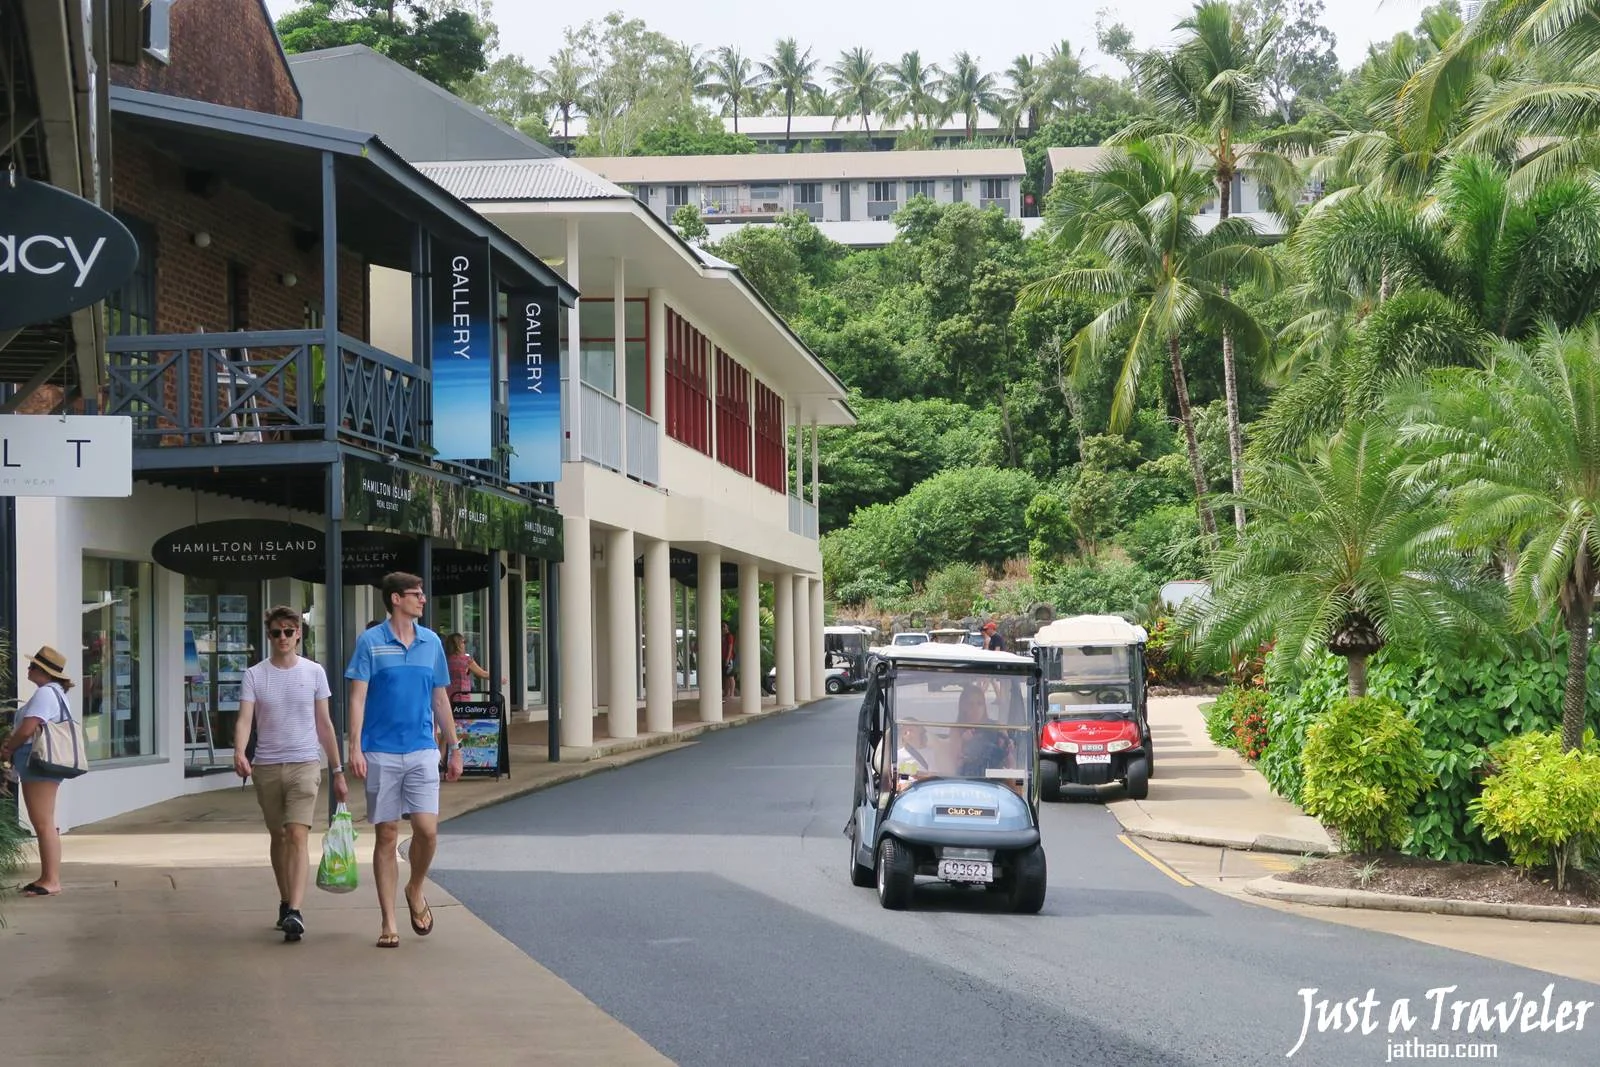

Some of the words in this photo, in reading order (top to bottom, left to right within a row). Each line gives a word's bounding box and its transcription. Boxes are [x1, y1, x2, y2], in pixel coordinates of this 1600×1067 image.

[452, 256, 470, 359] GALLERY
[525, 302, 542, 394] GALLERY
[362, 478, 391, 497] HAMILTON
[392, 486, 412, 502] ISLAND
[376, 500, 386, 509] REAL
[459, 508, 468, 520] ART
[468, 510, 488, 524] GALLERY
[524, 520, 542, 534] HAMILTON
[542, 525, 555, 537] ISLAND
[172, 541, 252, 553] HAMILTON
[260, 540, 317, 552] ISLAND
[241, 554, 277, 562] ESTATE
[464, 706, 487, 714] Gallery
[947, 807, 966, 815] Club
[967, 808, 983, 816] Car
